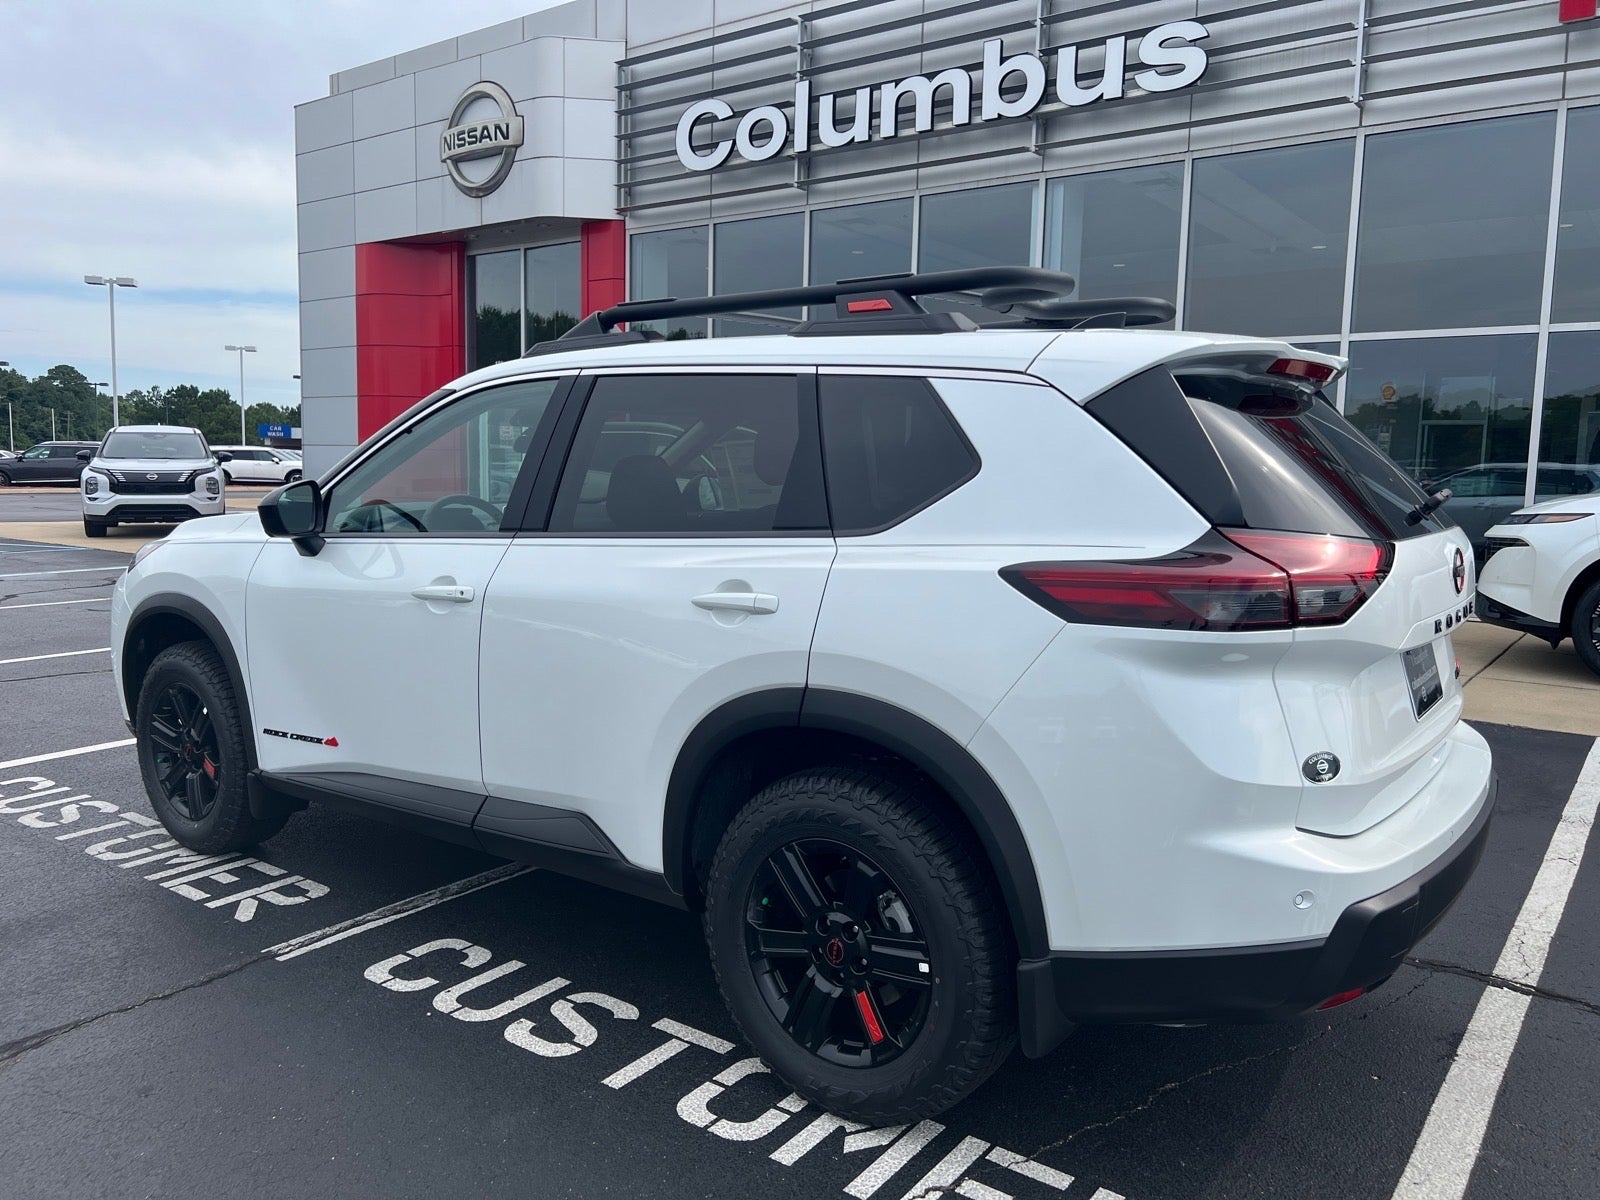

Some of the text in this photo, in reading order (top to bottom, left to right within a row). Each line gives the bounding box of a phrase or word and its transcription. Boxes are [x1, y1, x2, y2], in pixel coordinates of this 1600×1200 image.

[675, 20, 1210, 172] Columbus
[443, 123, 510, 154] NISSAN
[1434, 602, 1474, 634] ROGUE
[262, 728, 324, 745] ROCK CREEK
[363, 937, 1126, 1200] CUSTOME
